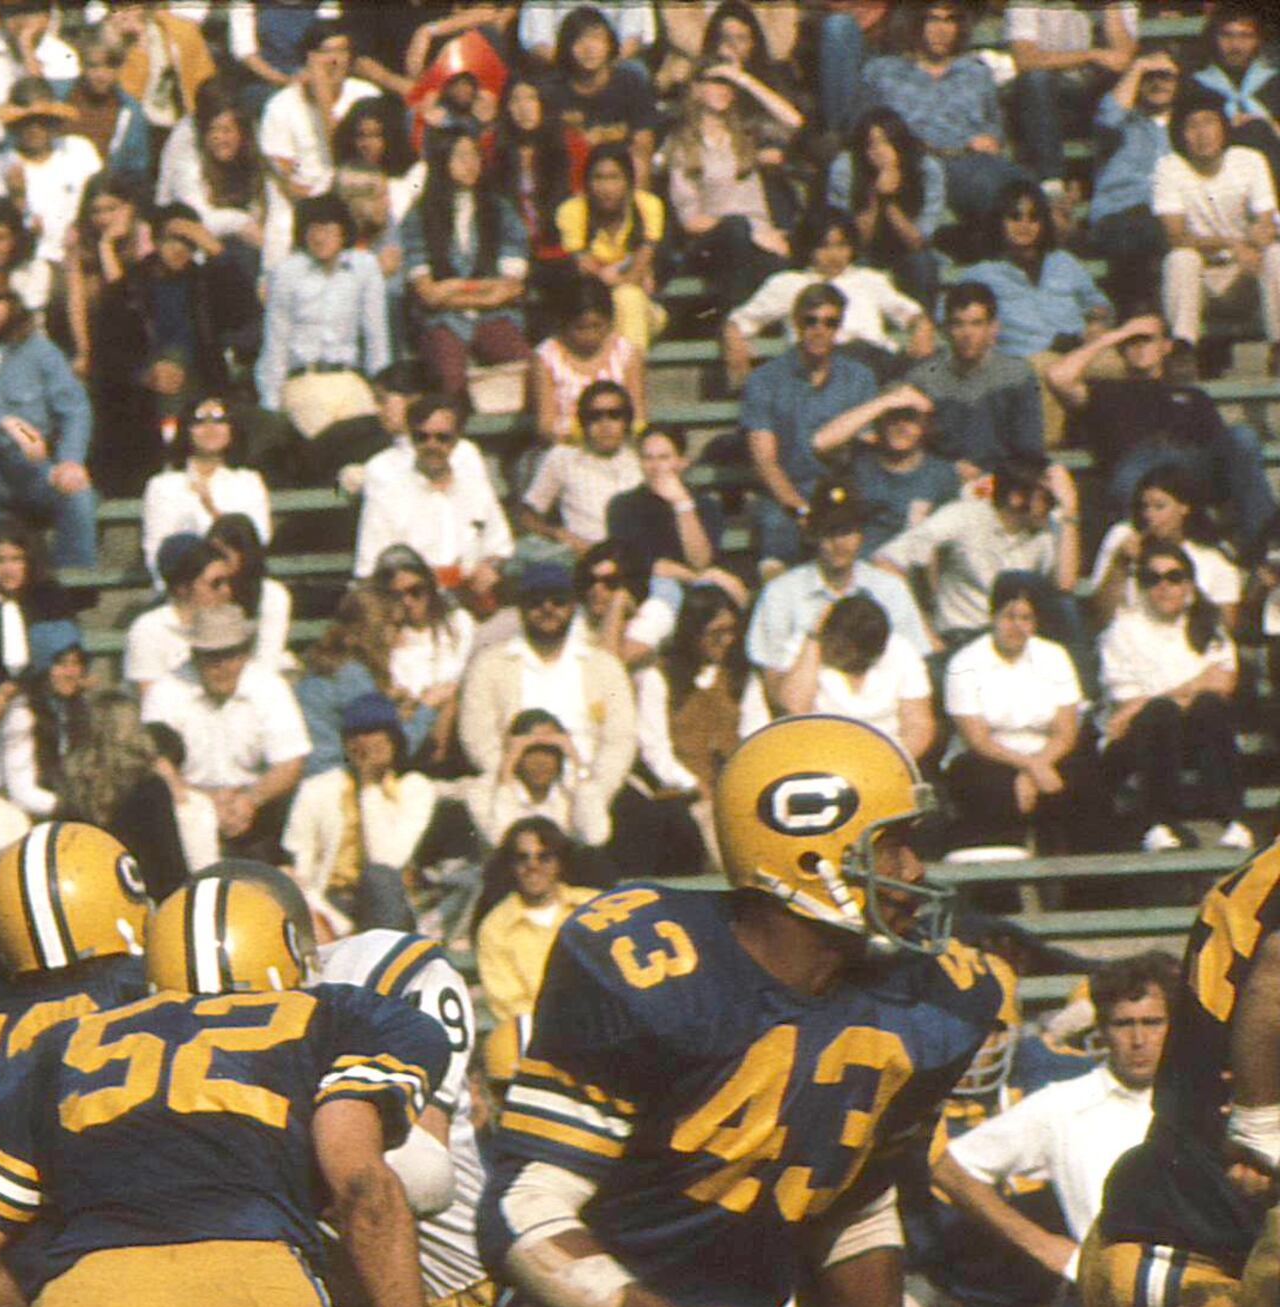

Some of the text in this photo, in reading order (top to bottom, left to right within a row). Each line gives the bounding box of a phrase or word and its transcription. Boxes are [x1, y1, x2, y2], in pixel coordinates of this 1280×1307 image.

[772, 776, 850, 828] C
[58, 989, 317, 1133] 52
[671, 1024, 913, 1222] 43
